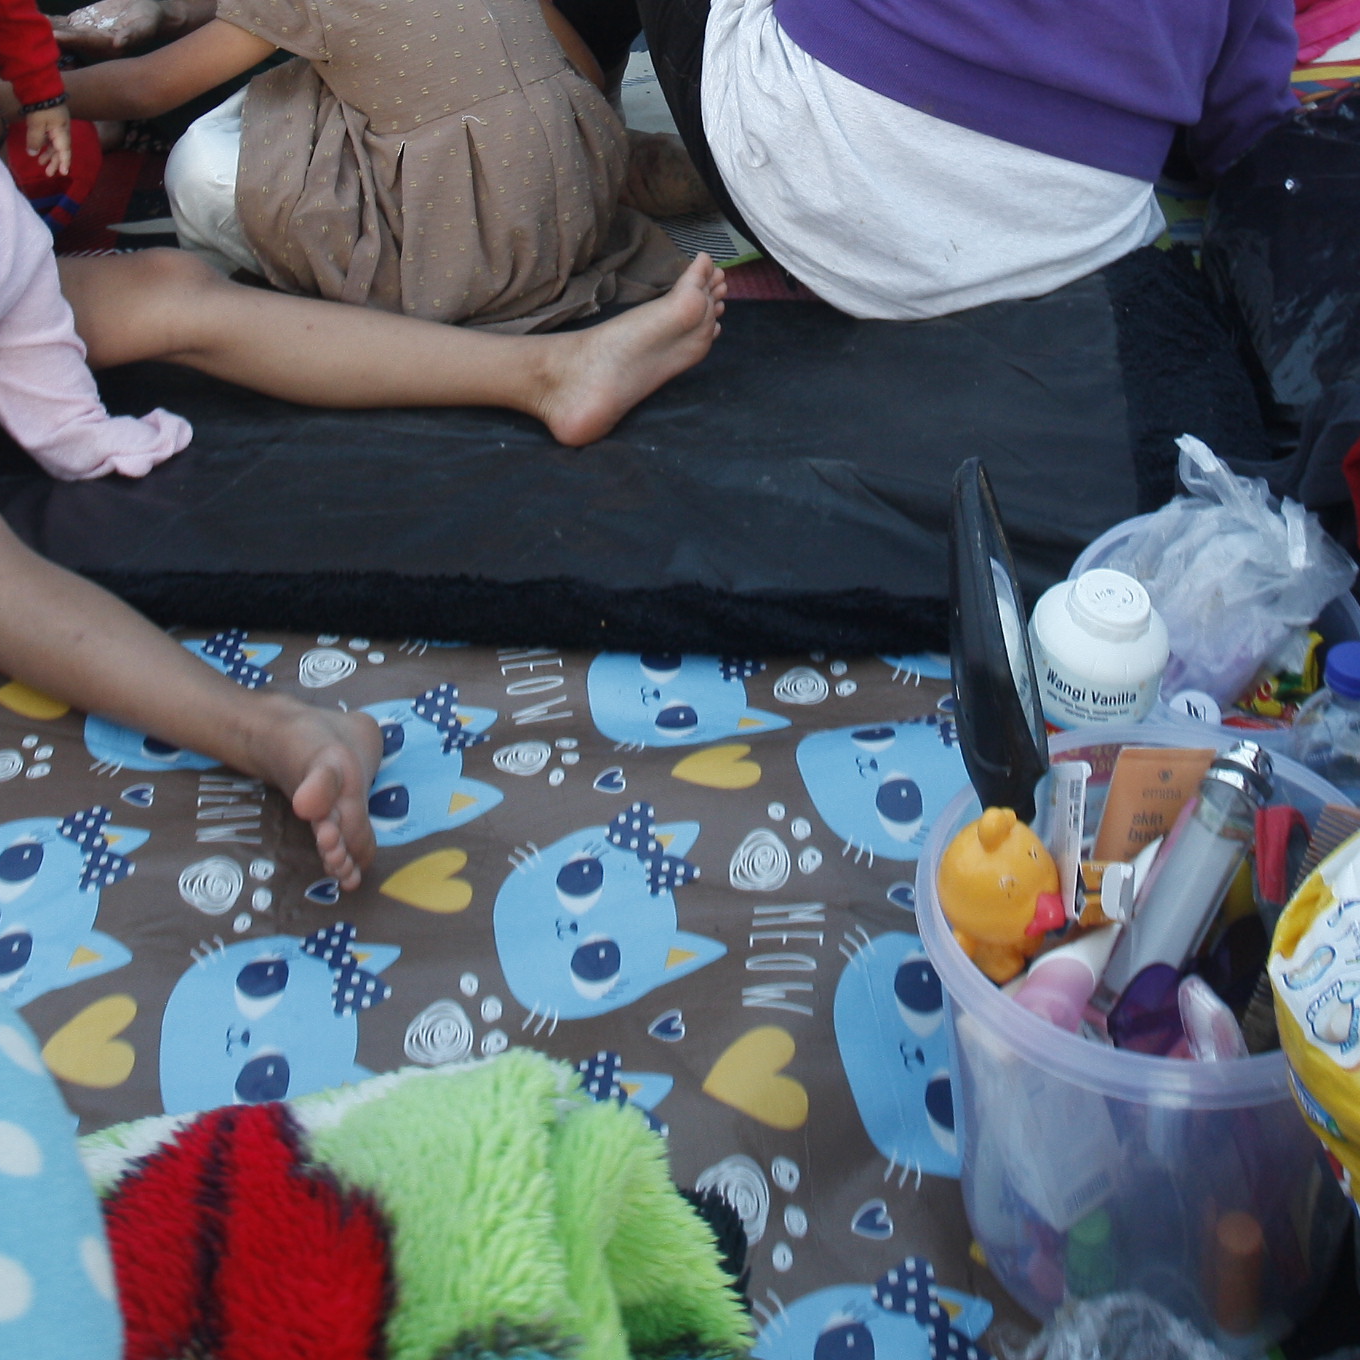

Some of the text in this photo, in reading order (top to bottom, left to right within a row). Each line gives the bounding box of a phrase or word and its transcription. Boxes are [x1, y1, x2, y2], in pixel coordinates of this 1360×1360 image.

[1046, 667, 1087, 703] Wangi
[1090, 690, 1137, 707] Vanilla
[741, 901, 826, 1017] MEOW
